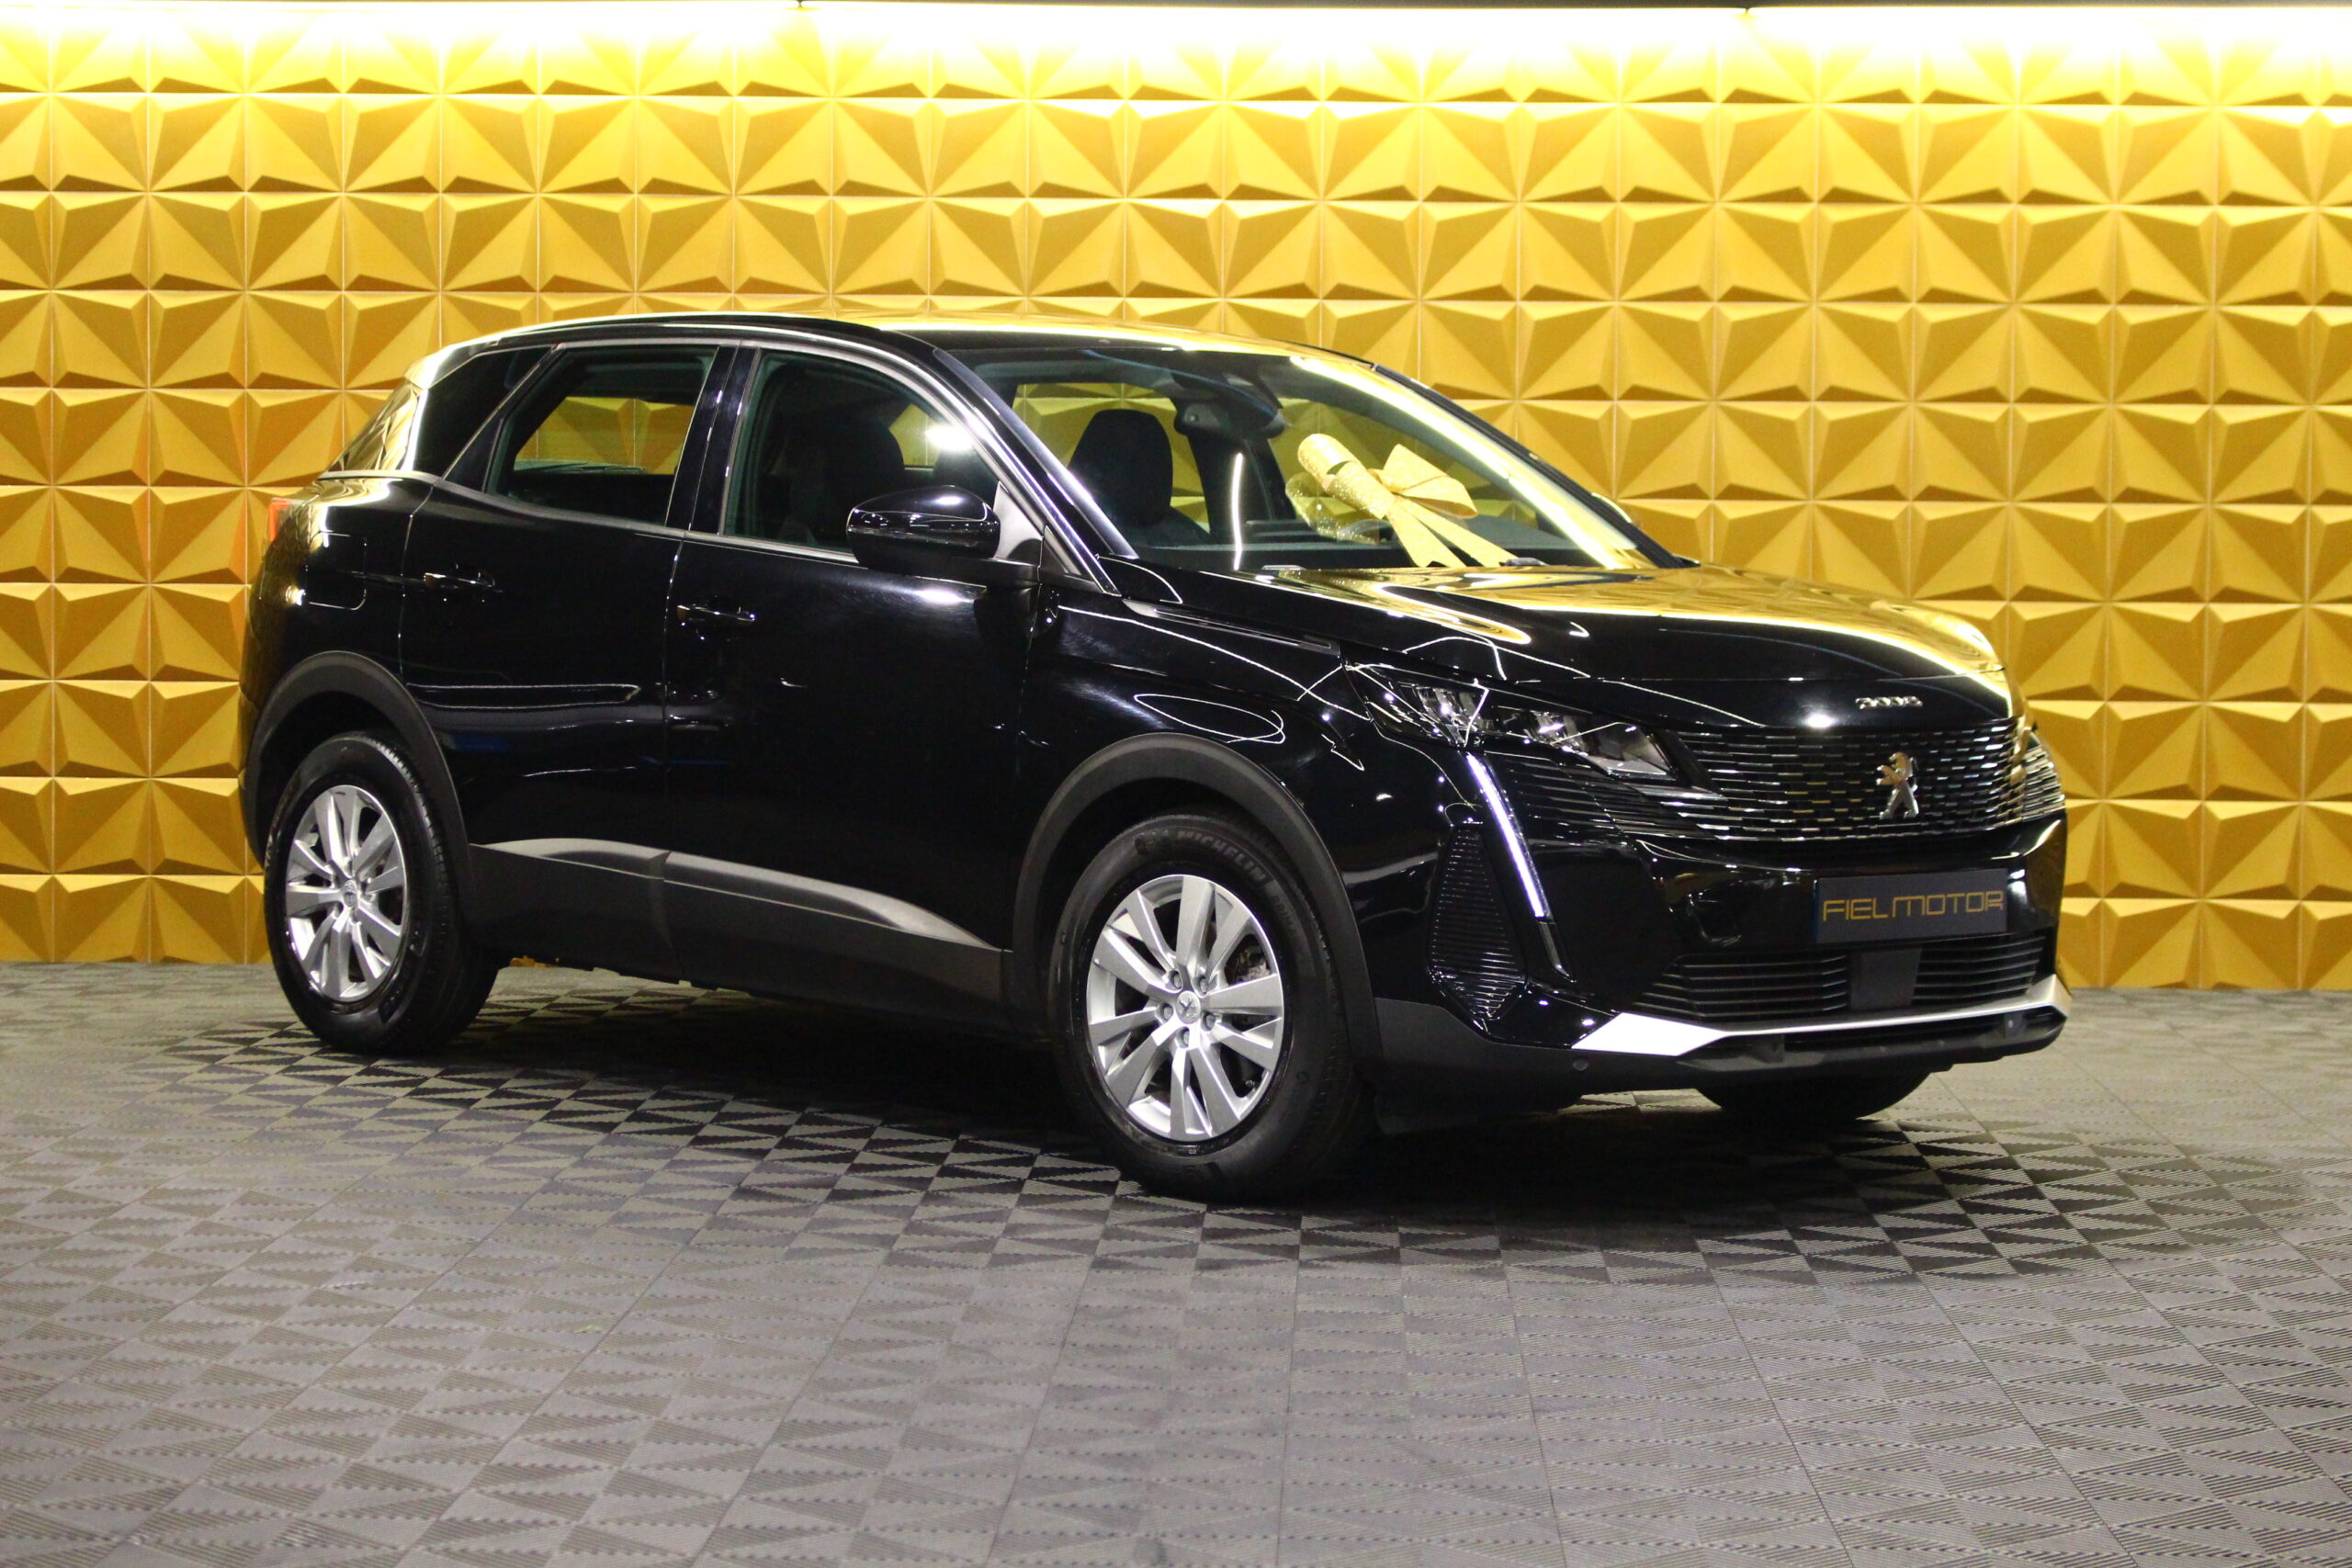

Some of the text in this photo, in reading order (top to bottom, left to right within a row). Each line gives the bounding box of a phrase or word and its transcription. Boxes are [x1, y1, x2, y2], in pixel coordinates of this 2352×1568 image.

[1176, 829, 1268, 883] MICHELIN
[1822, 889, 2004, 922] FIEL MOTOR
